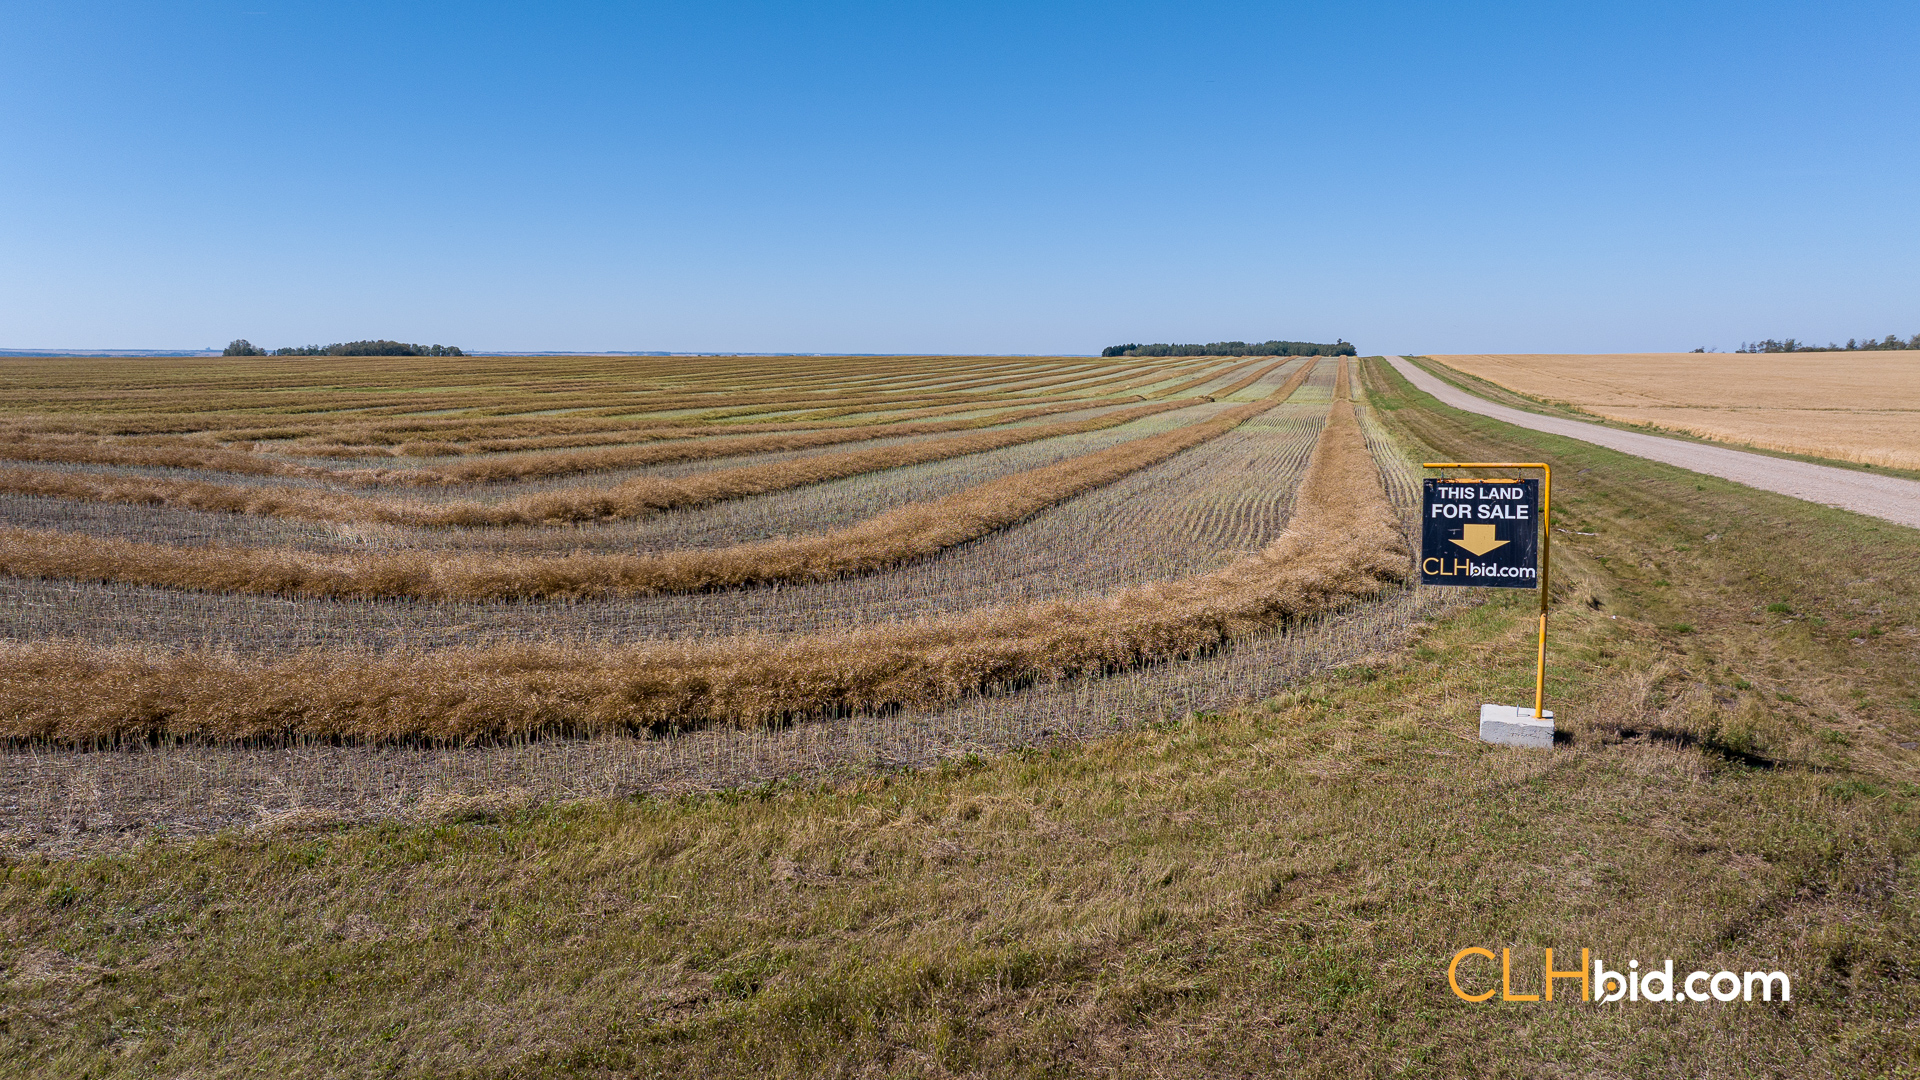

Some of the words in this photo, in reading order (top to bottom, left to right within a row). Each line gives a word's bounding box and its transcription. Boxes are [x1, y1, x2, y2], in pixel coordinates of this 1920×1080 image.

[1437, 487, 1475, 500] THIS
[1479, 487, 1524, 500] LAND
[1431, 503, 1472, 519] FOR
[1477, 504, 1529, 520] SALE
[1422, 557, 1536, 578] CLHbid.com
